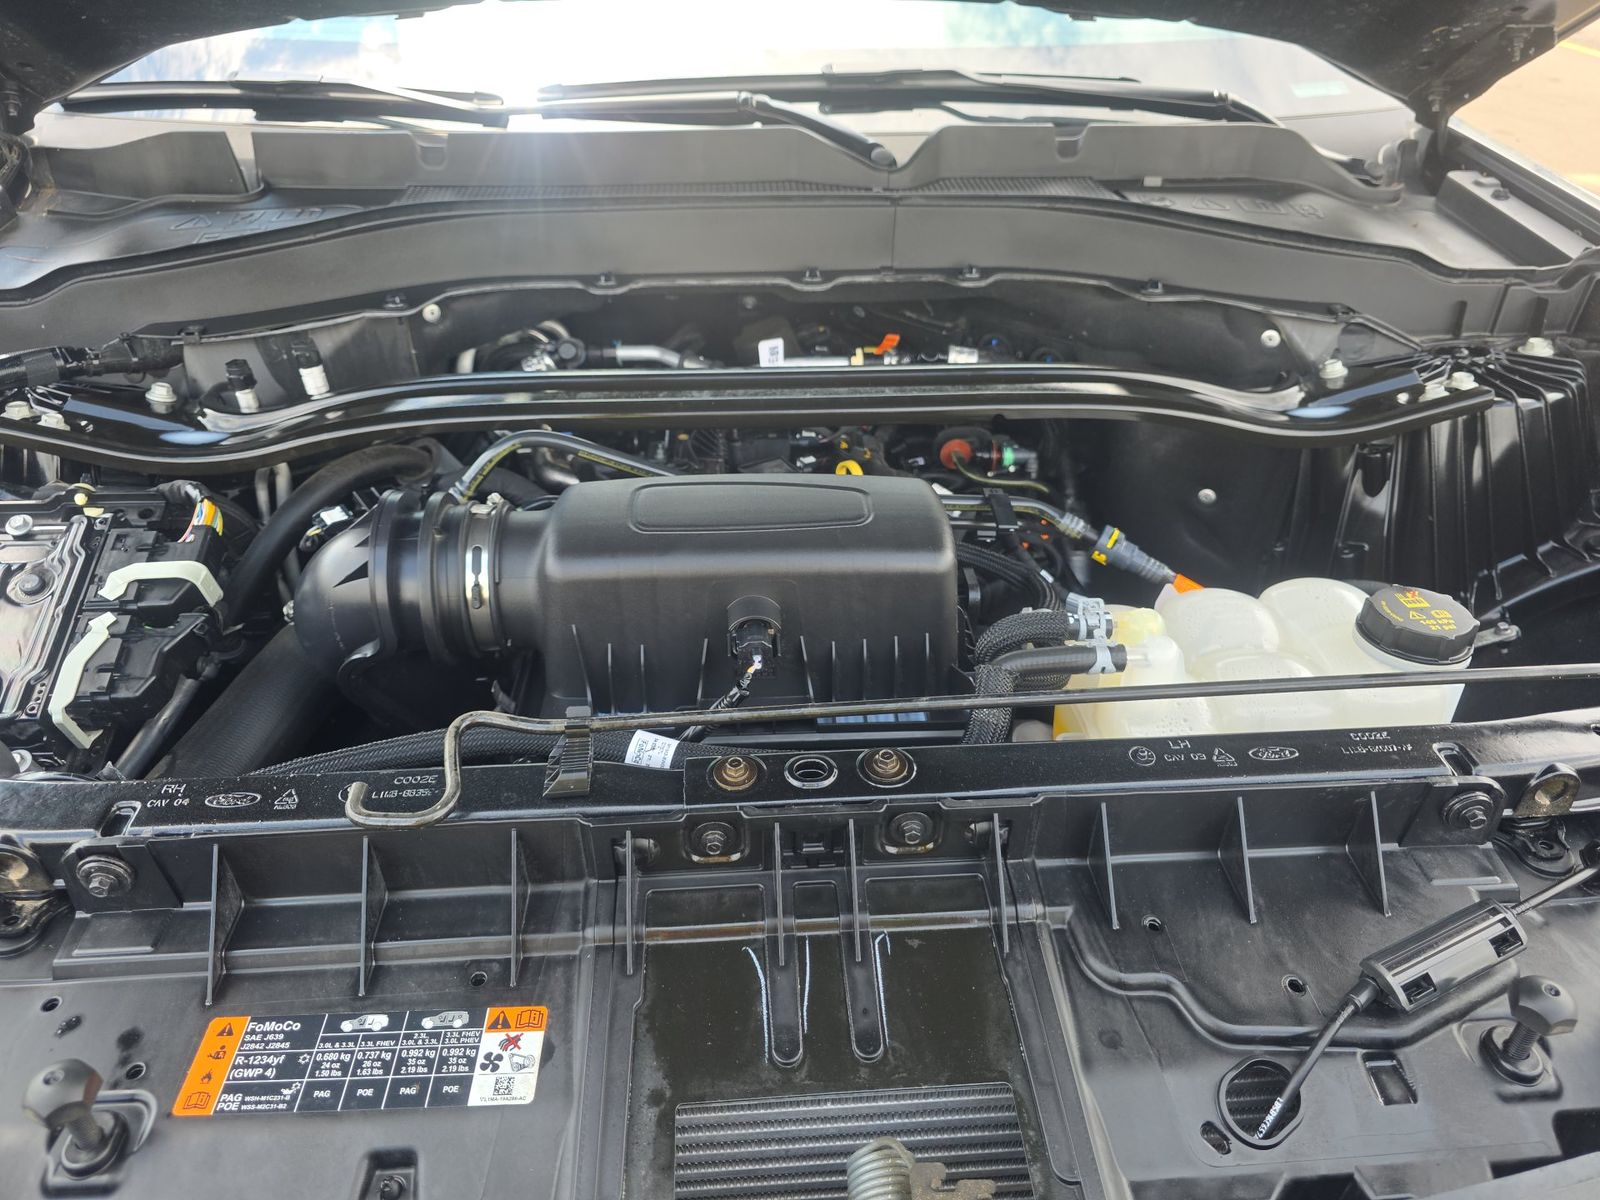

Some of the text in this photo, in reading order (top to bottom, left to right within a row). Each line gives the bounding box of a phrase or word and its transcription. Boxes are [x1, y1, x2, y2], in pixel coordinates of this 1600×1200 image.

[1168, 740, 1191, 749] LH
[1164, 754, 1185, 762] CAV
[161, 784, 186, 794] RH
[146, 798, 190, 808] CAV 04
[247, 1020, 301, 1032] FoMoCo
[316, 1052, 351, 1062] 0.680 kg
[357, 1051, 392, 1060] 0.737 kg
[401, 1049, 436, 1058] 0.992 kg
[442, 1048, 476, 1058] 0.992 kg
[235, 1054, 285, 1066] R-1234yf
[230, 1068, 276, 1080] (GWP 4)
[356, 1068, 371, 1076] 1.63
[220, 1094, 242, 1102] PAG
[313, 1090, 331, 1098] PAG
[216, 1102, 240, 1110] POE
